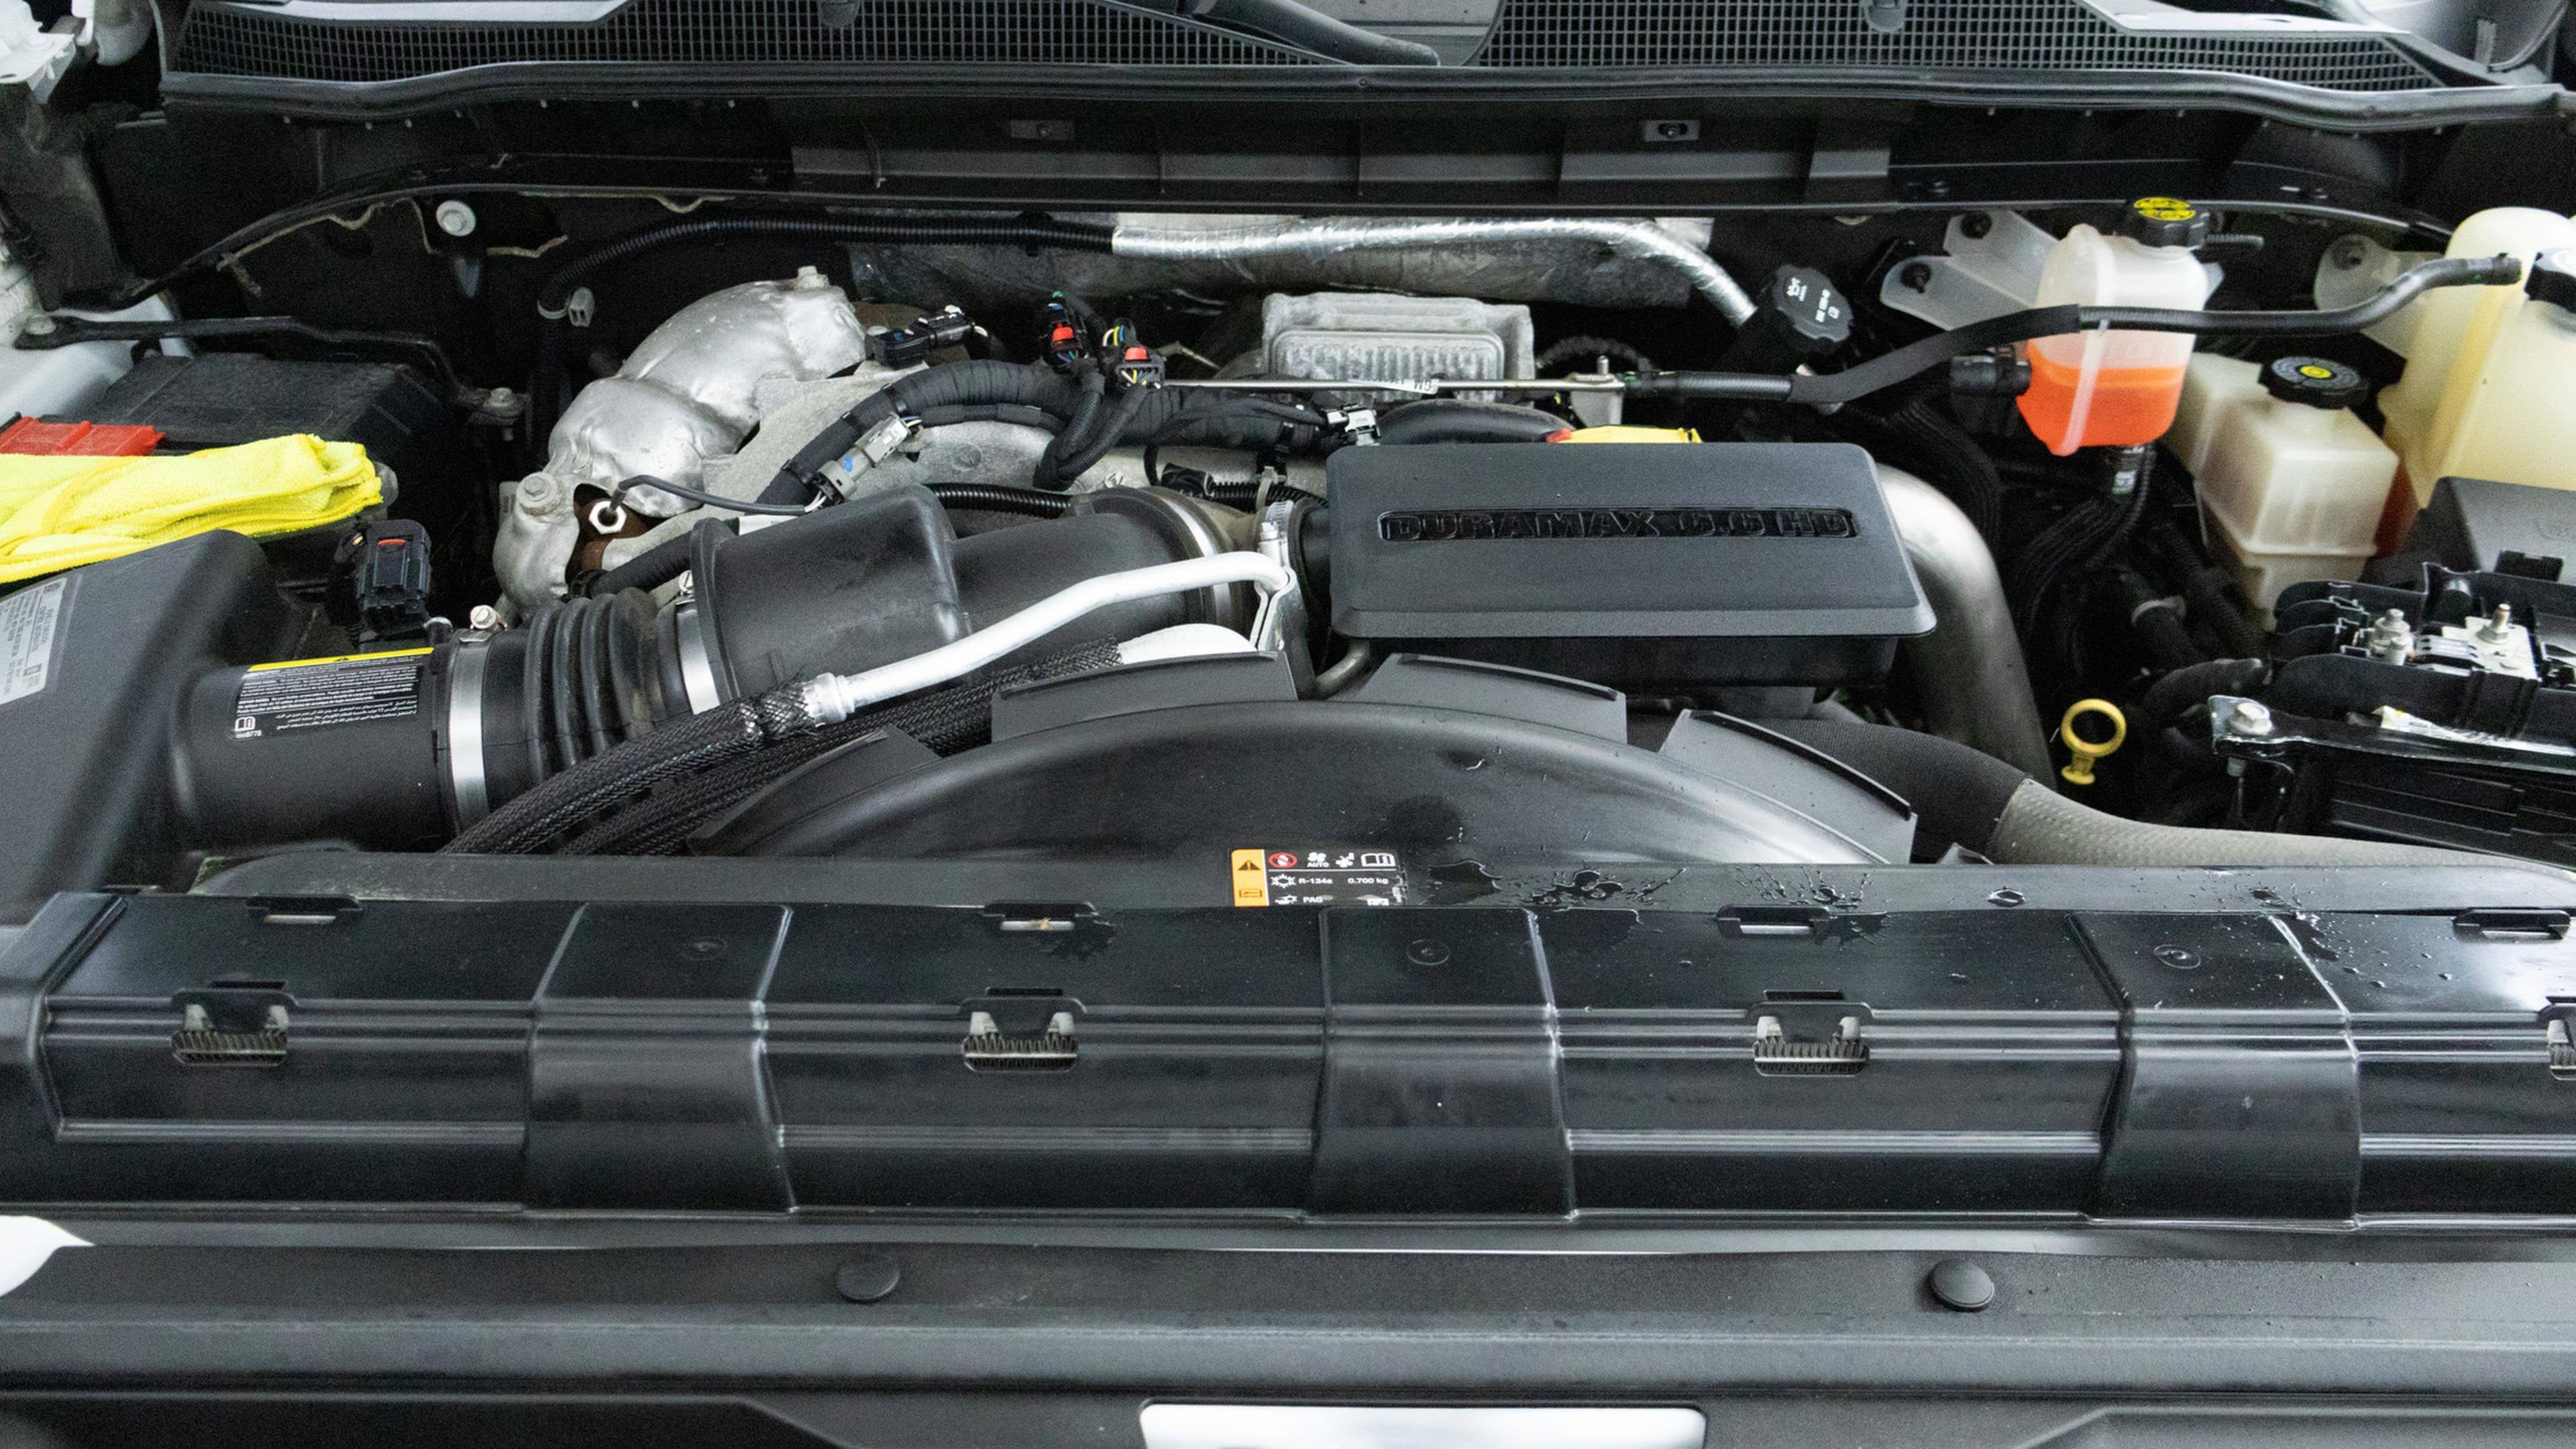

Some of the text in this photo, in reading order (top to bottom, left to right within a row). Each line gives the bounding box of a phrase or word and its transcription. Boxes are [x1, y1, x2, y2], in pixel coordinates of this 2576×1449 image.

[1387, 513, 1660, 539] DURAMAX
[1776, 511, 1849, 537] HD
[1376, 877, 1389, 885] kg
